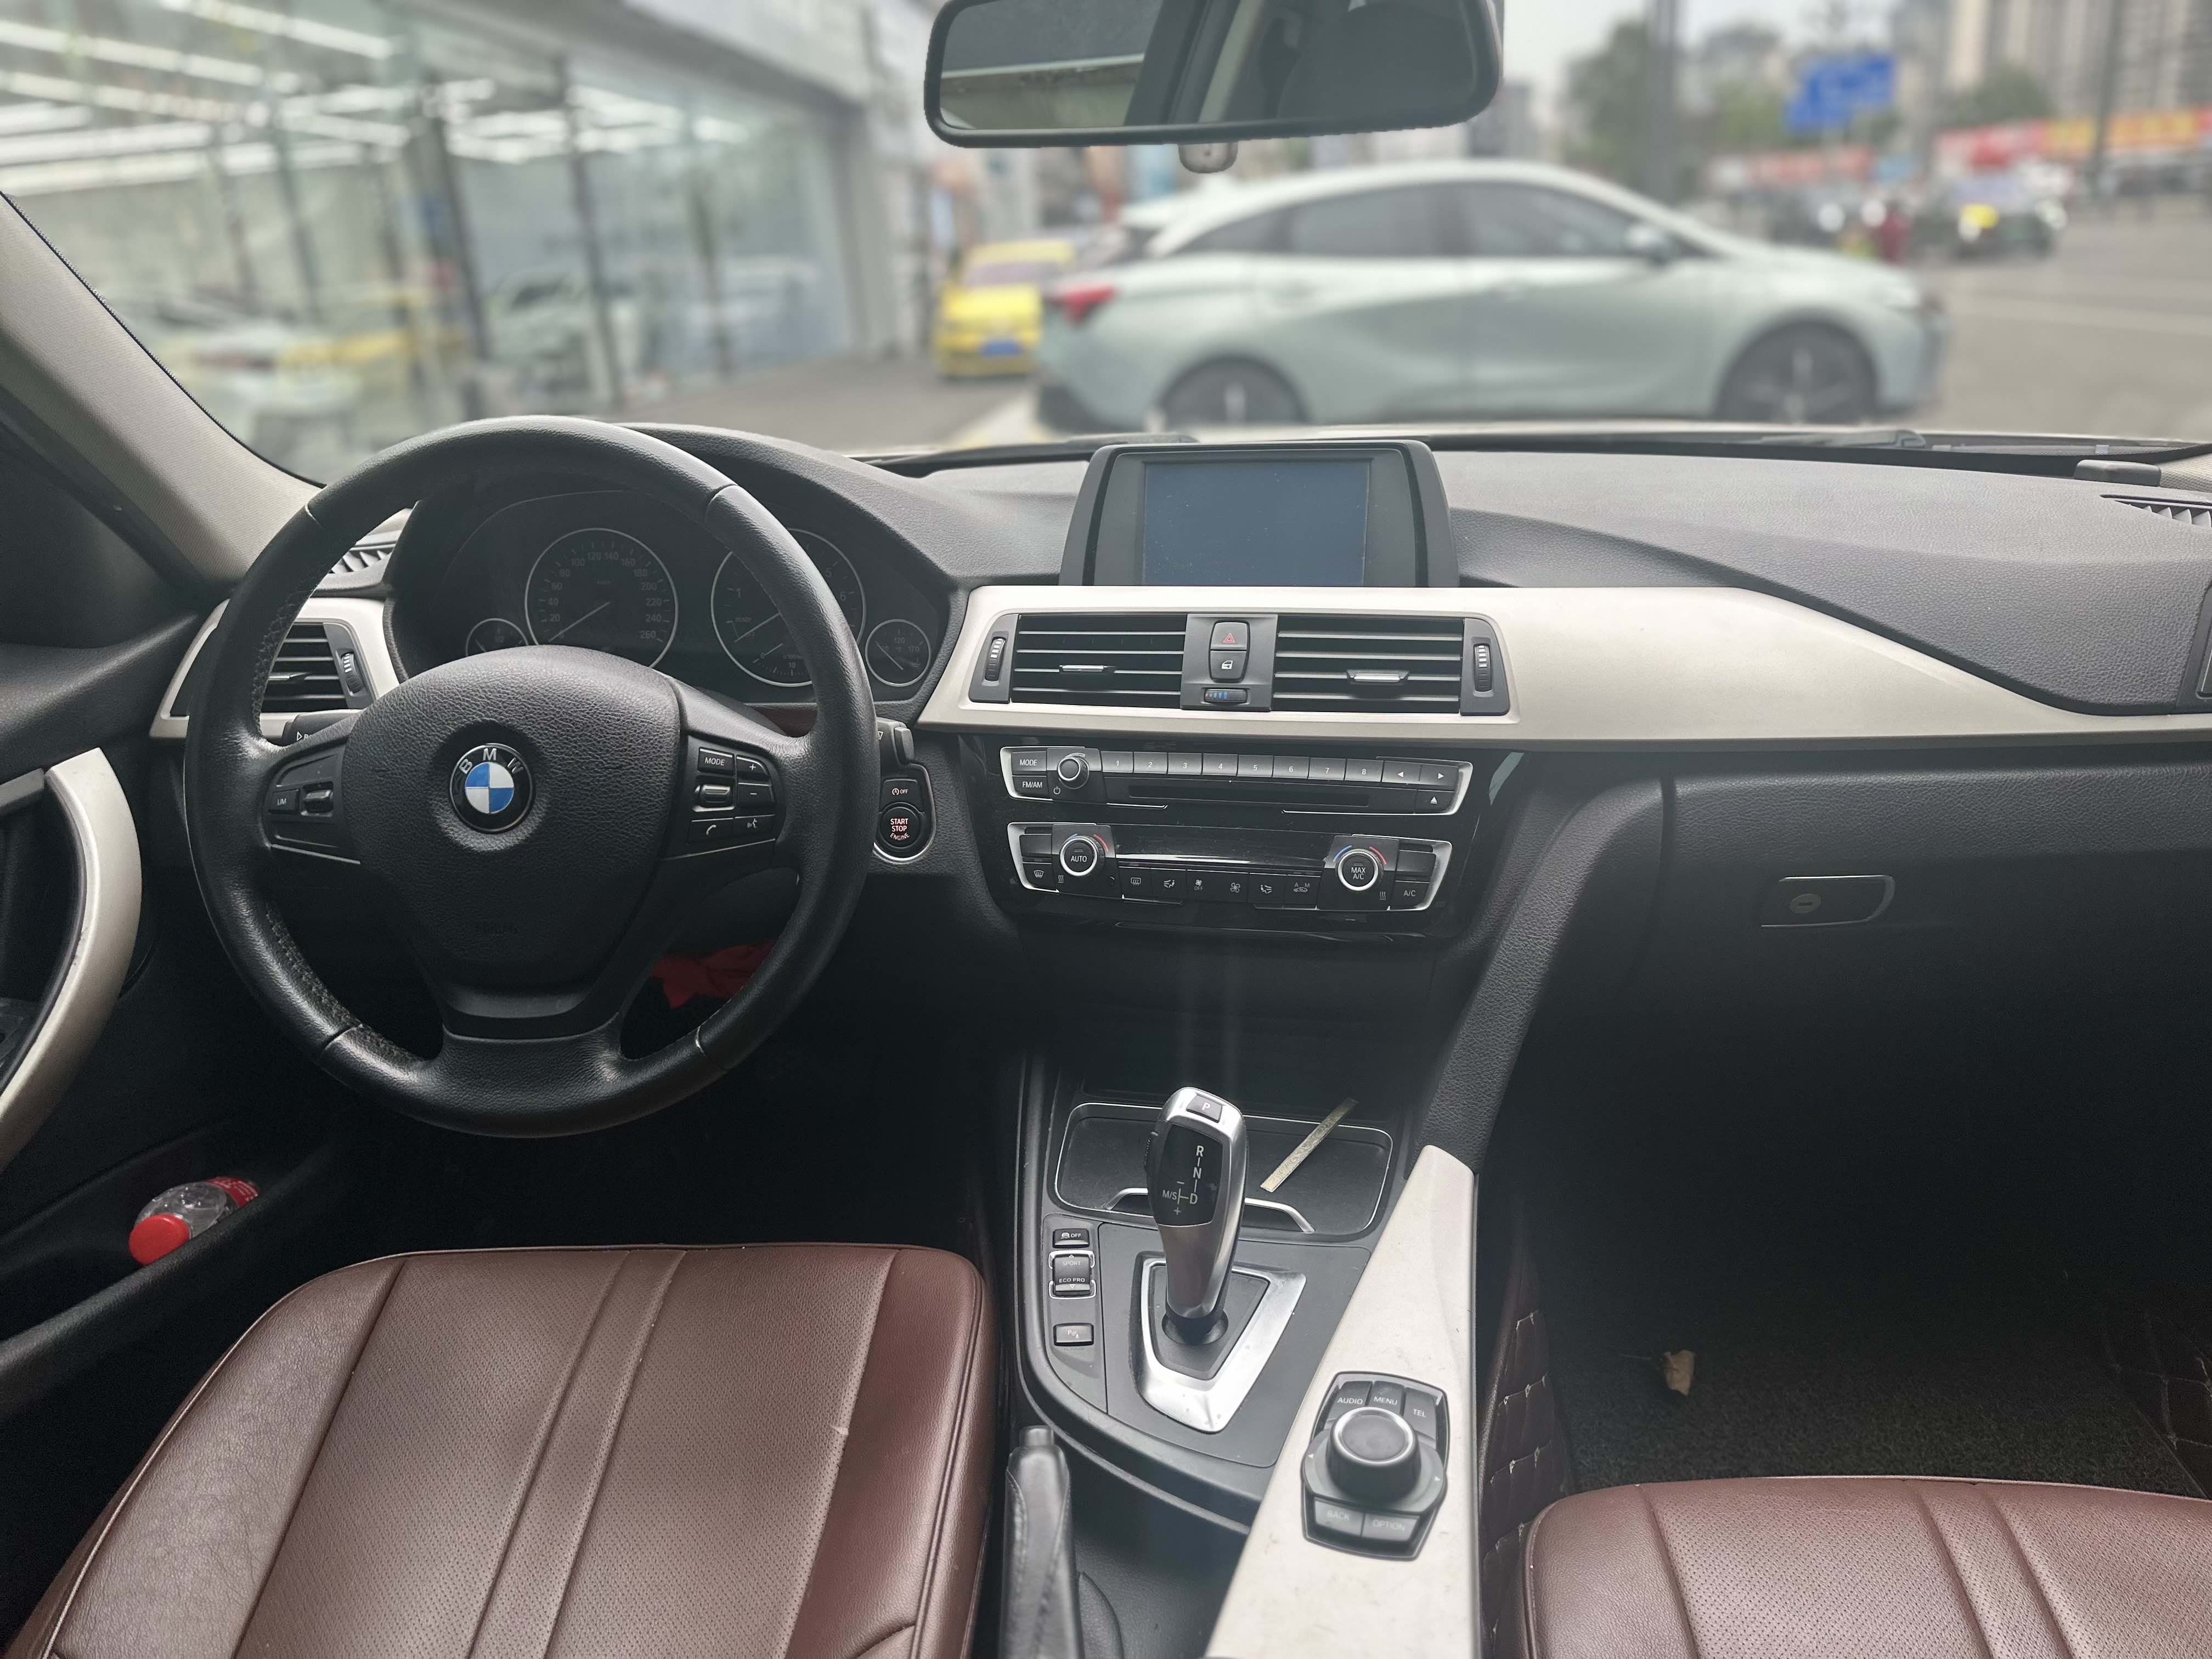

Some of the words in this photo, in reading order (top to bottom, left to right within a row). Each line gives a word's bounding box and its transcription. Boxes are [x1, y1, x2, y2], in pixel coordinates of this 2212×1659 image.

[825, 567, 832, 577] 5
[736, 588, 741, 597] 1
[839, 591, 847, 601] 6
[646, 598, 662, 606] 220
[550, 614, 561, 622] 20
[645, 614, 662, 623] 240
[459, 748, 523, 774] BMW
[704, 757, 725, 766] MODE
[890, 832, 910, 840] ENGINE
[1201, 1102, 1210, 1111] P
[1196, 1145, 1204, 1157] R
[1193, 1166, 1202, 1179] N
[1162, 1189, 1177, 1200] M/S
[1189, 1193, 1198, 1205] D
[1374, 1396, 1398, 1406] MENU
[1413, 1408, 1426, 1418] TEL
[1326, 1510, 1350, 1521] BACK
[1373, 1519, 1405, 1532] OPTION
